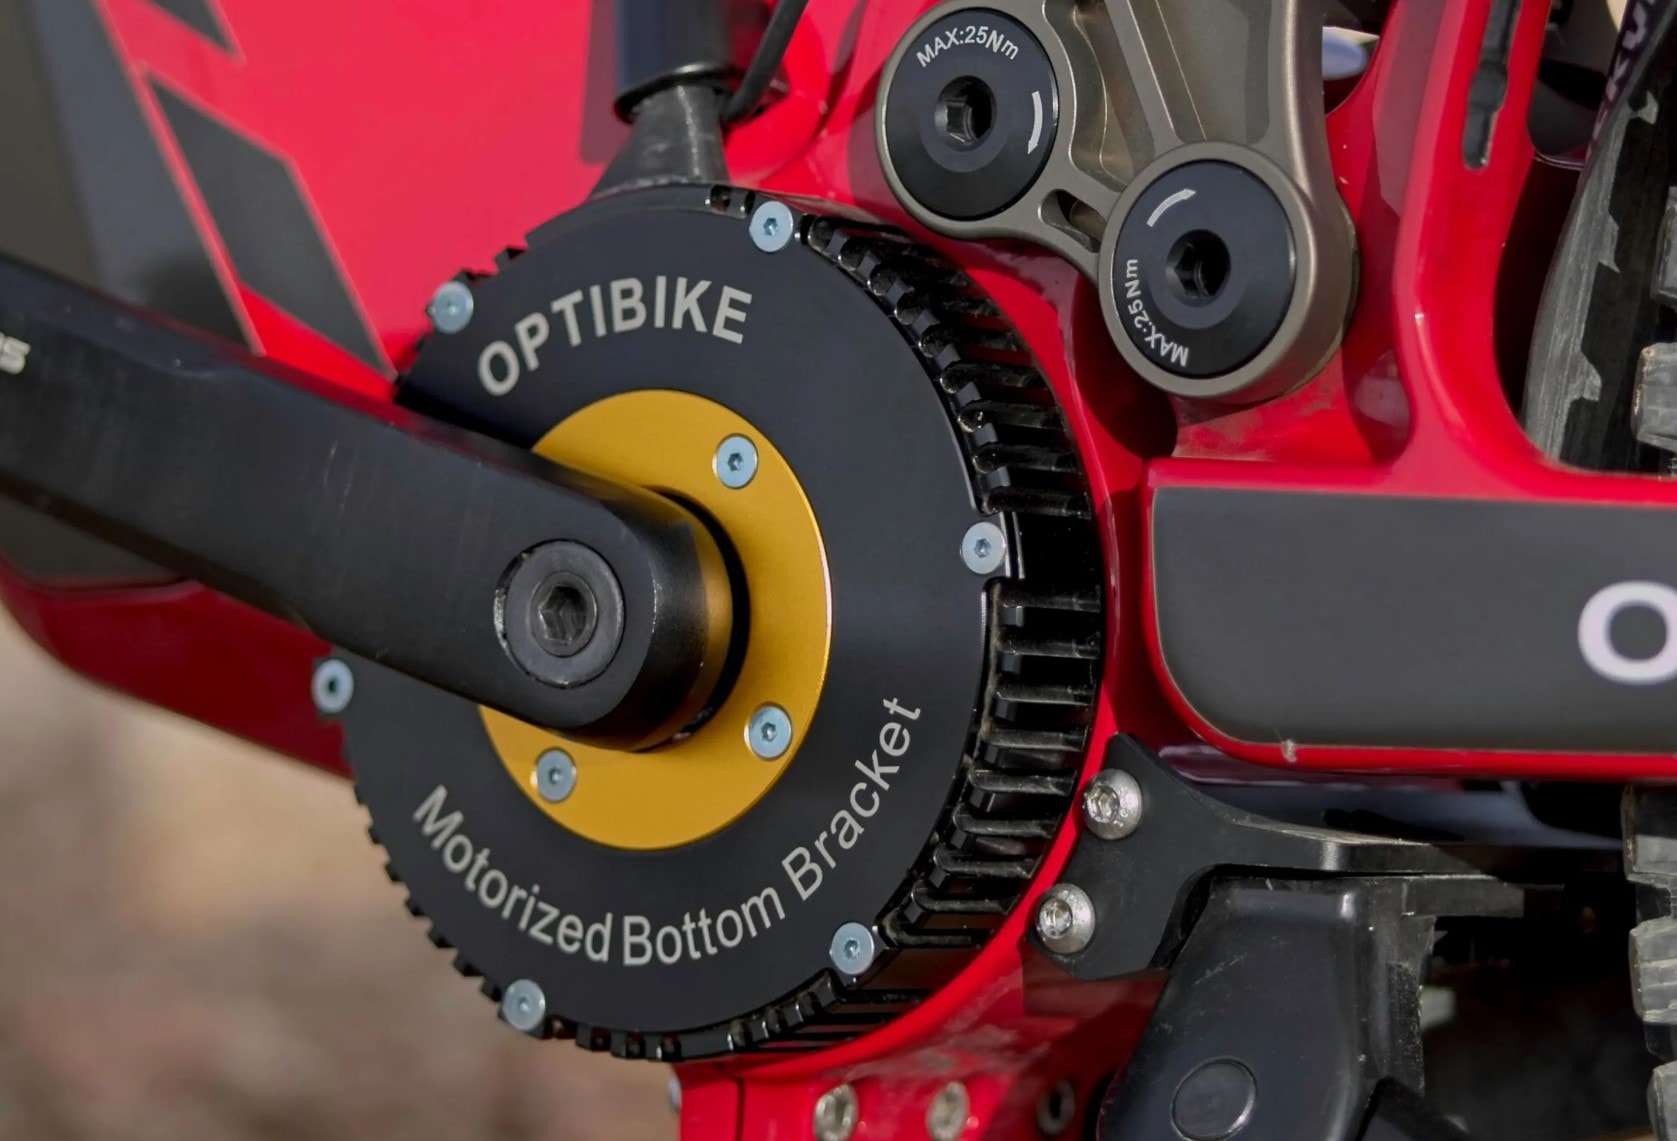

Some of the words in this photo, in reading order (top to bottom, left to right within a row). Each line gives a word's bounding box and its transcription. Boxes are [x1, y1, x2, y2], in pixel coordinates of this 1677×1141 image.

[916, 25, 1019, 68] MAX:25Nm
[477, 275, 753, 396] OPTIBIKE
[1124, 259, 1189, 367] MAX:25Nm
[413, 785, 613, 963] Motorized
[622, 885, 787, 967] Bottom
[781, 696, 921, 902] Bracket
